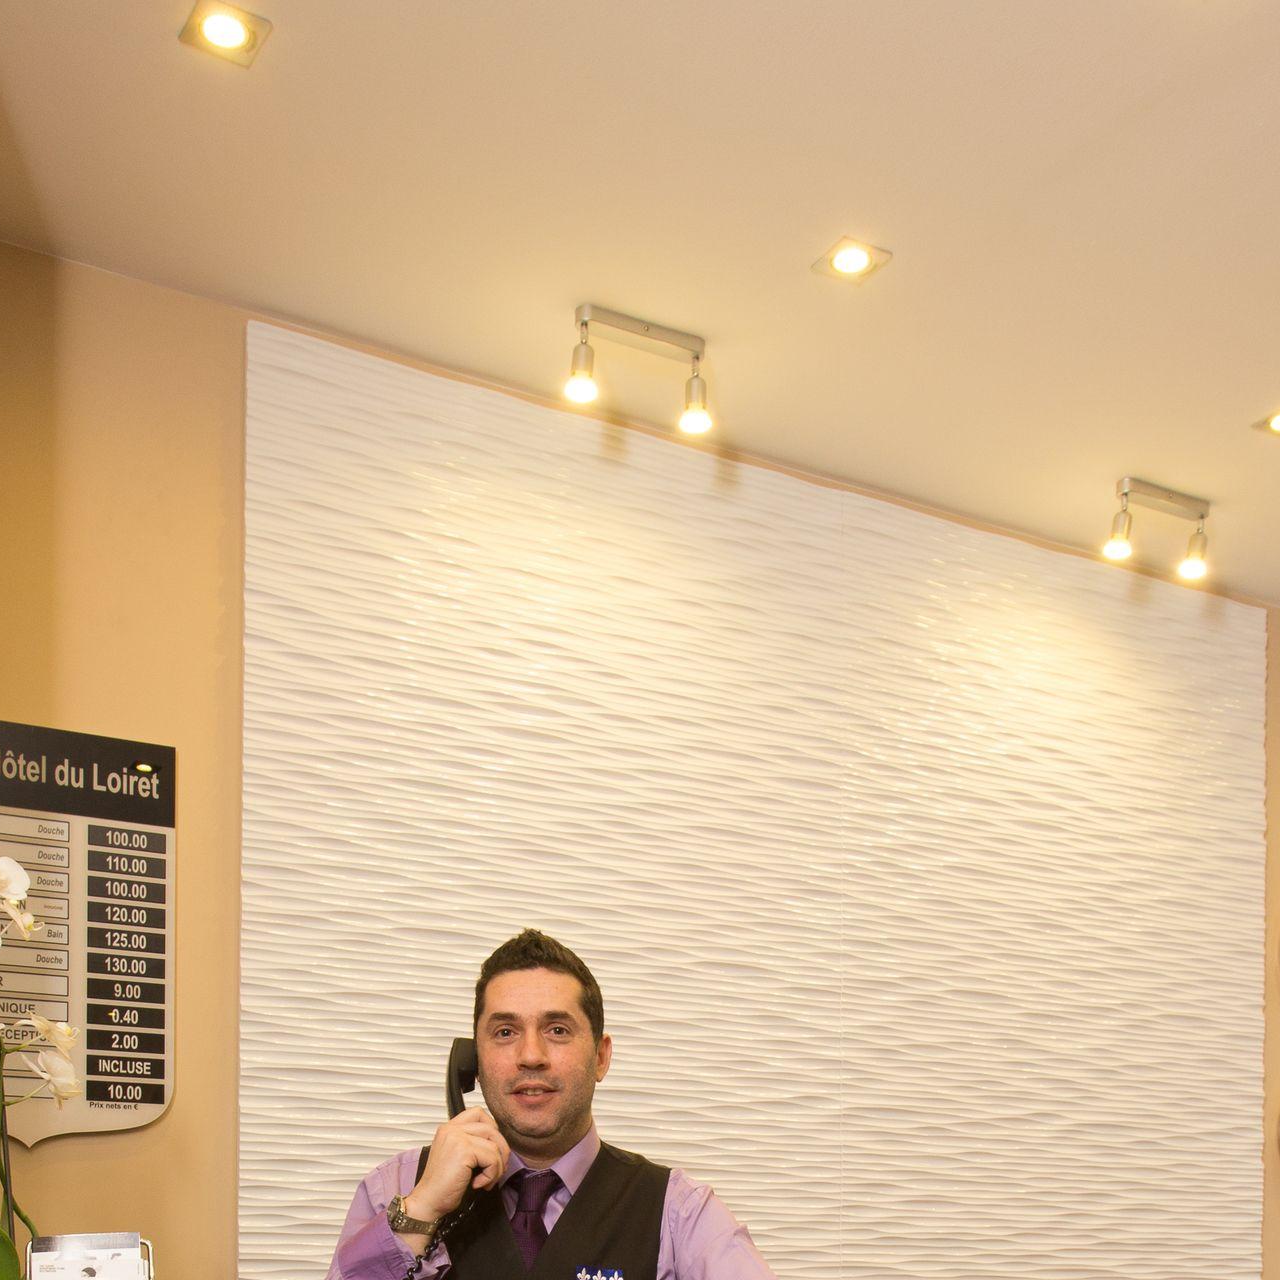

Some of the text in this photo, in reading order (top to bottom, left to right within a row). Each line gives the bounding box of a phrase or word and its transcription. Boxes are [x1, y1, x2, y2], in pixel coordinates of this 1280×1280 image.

[54, 759, 84, 788] du
[92, 763, 160, 800] Loiret
[37, 825, 65, 836] Douche
[106, 830, 148, 849] 100.00
[37, 850, 65, 861] Douche
[106, 855, 147, 874] 110.00
[37, 876, 64, 887] Douche
[105, 880, 147, 899] 100.00
[105, 906, 146, 924] 120.00
[47, 929, 63, 939] Bain
[105, 931, 146, 950] 125.00
[36, 954, 64, 965] Douche
[104, 957, 146, 975] 130.00
[114, 983, 141, 999] 9.00
[112, 1008, 139, 1024] 0.40
[111, 1034, 138, 1050] 2.00
[98, 1059, 151, 1075] INCLUSE
[108, 1084, 142, 1100] 10.00
[89, 1101, 104, 1109] Prix
